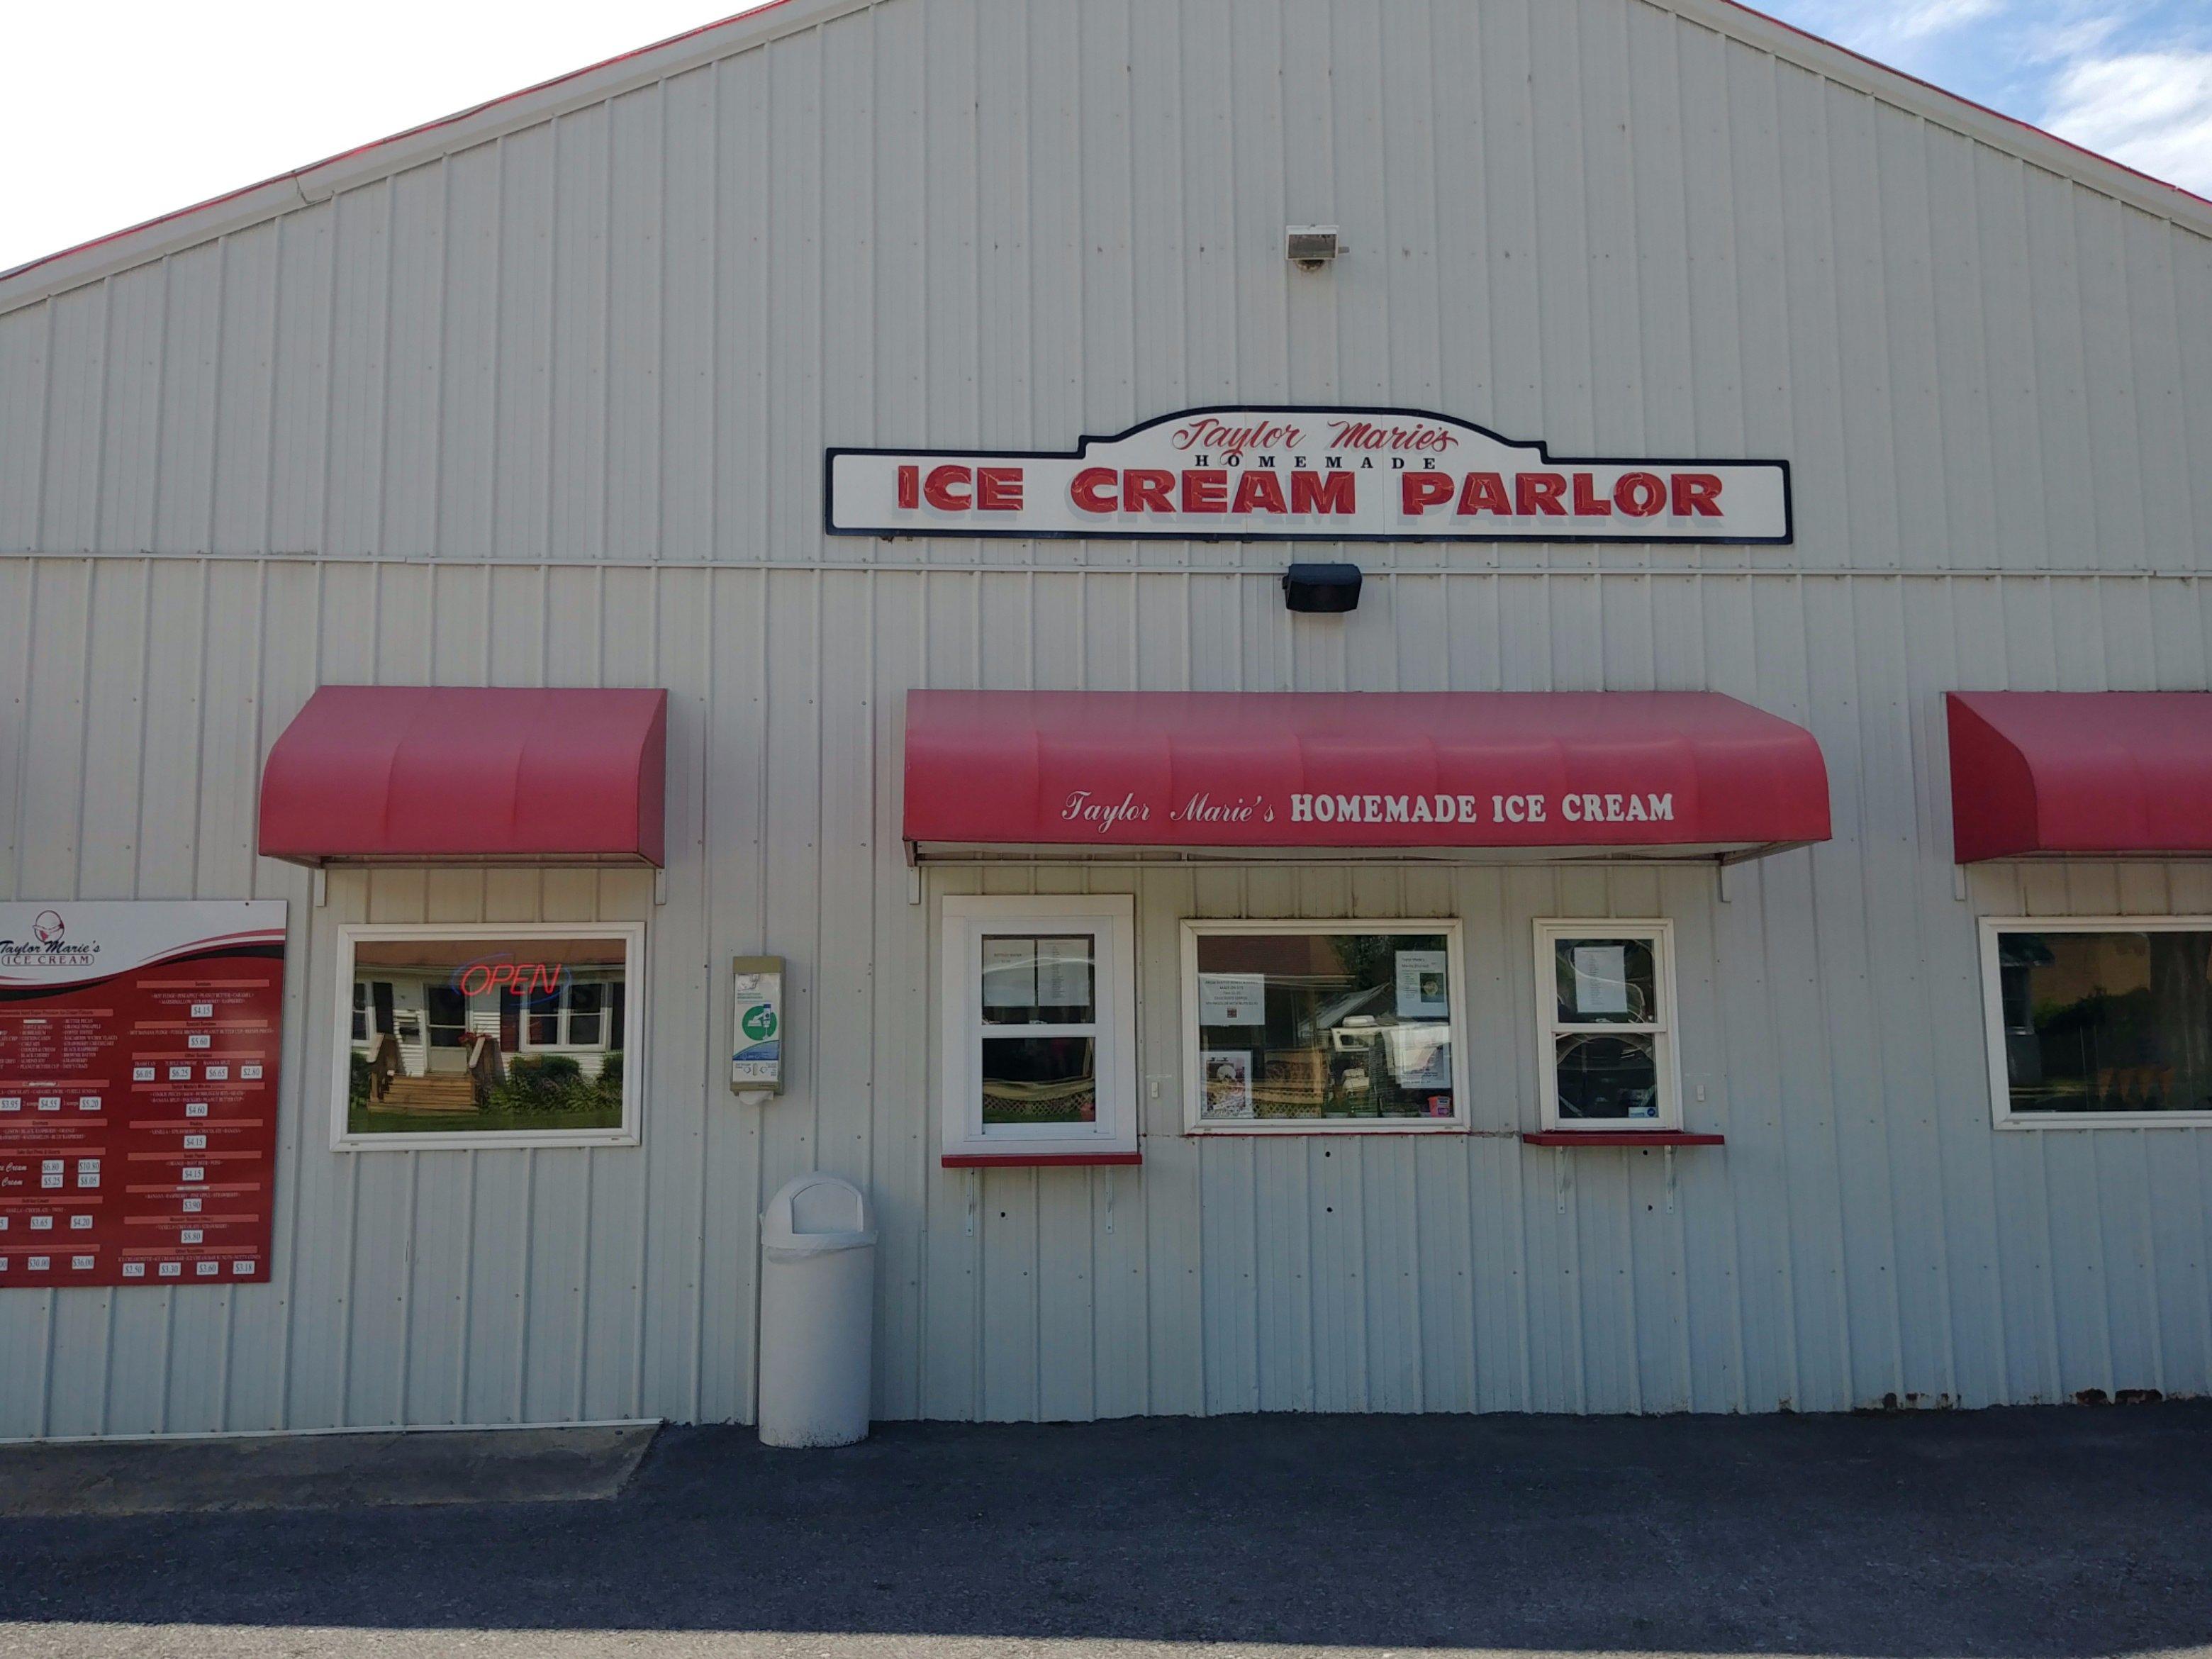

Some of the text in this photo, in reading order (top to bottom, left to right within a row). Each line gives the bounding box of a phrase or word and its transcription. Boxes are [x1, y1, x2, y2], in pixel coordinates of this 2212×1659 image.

[1171, 418, 1459, 465] Taylor Marie's
[1195, 454, 1435, 469] HOMEMADE
[897, 465, 1724, 518] ICE CREAM PARLOR
[1062, 791, 1675, 834] Taylor Marie's HOMEMADE ICE CREAM
[0, 940, 101, 956] Taylor Marie's
[7, 956, 89, 965] ICE CREAM
[459, 963, 562, 996] OPEN
[193, 1007, 211, 1015] $4.15
[191, 1037, 208, 1046] $5.60
[135, 1070, 152, 1078] $6.05
[208, 1069, 225, 1078] $6.65
[243, 1068, 260, 1076] $2.80
[1, 1100, 18, 1109] $3.95
[40, 1100, 58, 1109] $4.55
[82, 1100, 99, 1108] $5.20
[189, 1106, 206, 1115] $4.60
[186, 1138, 203, 1146] $4.15
[6, 1162, 28, 1173] Cream
[43, 1163, 60, 1171] $6.80
[79, 1162, 100, 1171] $10.80
[184, 1170, 201, 1178] $4.15
[1, 1177, 23, 1187] Cream
[44, 1177, 61, 1186] $5.25
[184, 1201, 201, 1210] $3.90
[31, 1219, 48, 1227] $3.65
[73, 1218, 90, 1227] $4.20
[184, 1232, 201, 1241] $8.80
[29, 1259, 50, 1268] $30.00
[73, 1258, 93, 1267] $36.00
[125, 1266, 143, 1274] $2.50
[161, 1265, 178, 1273] $3.30
[199, 1264, 216, 1273] $3.60
[235, 1263, 252, 1272] $3.18
